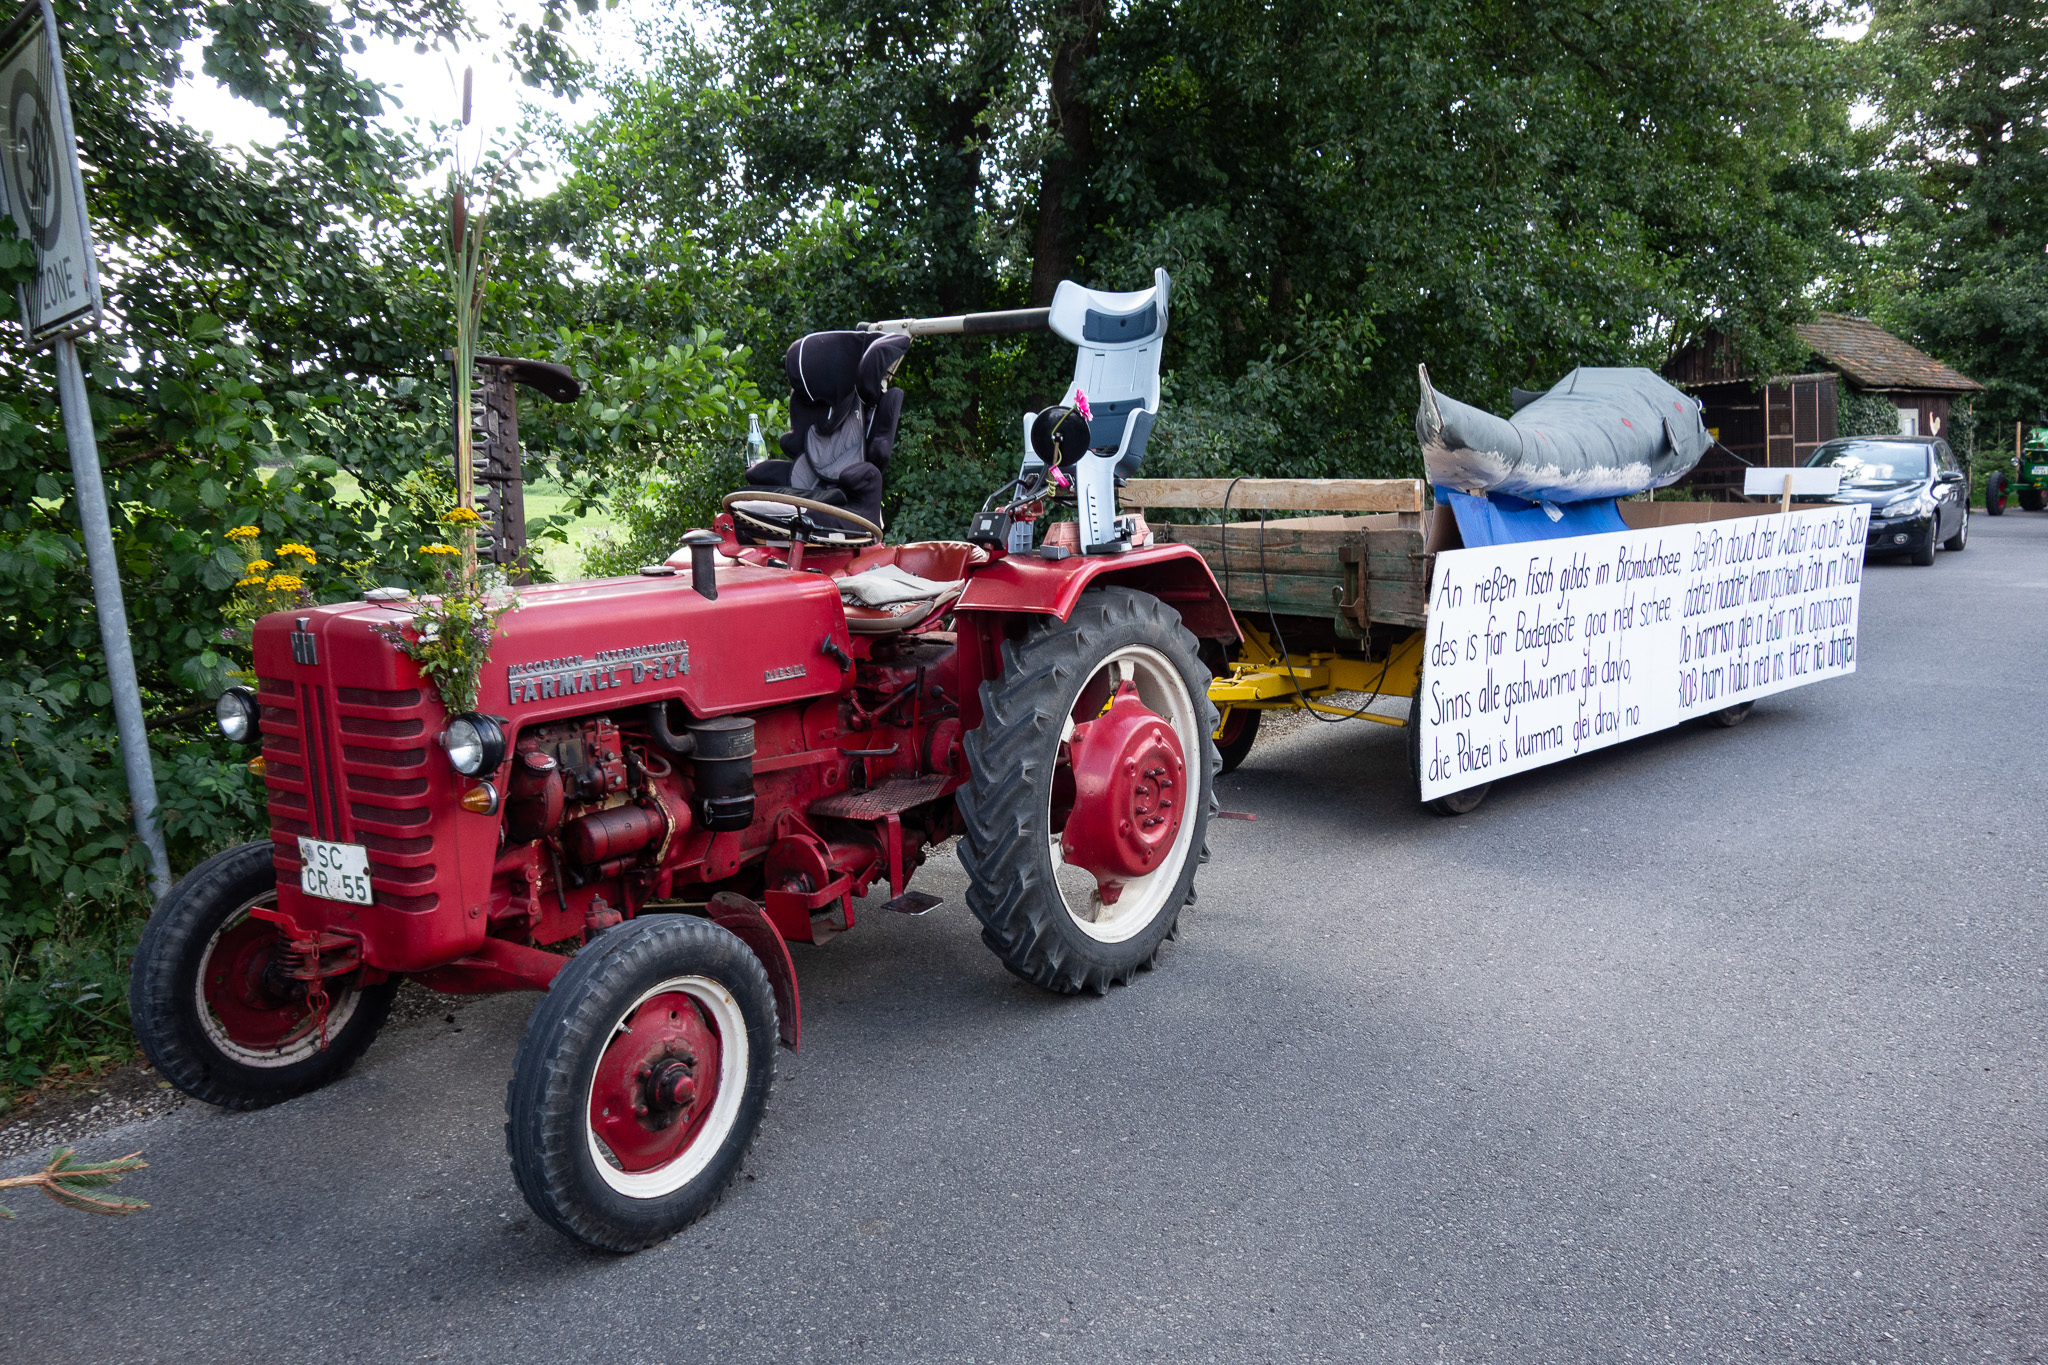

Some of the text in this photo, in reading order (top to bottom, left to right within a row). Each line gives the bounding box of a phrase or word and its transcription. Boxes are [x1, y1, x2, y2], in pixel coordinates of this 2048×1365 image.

[39, 256, 76, 311] ZONE
[1757, 518, 1777, 560] der
[1778, 513, 1812, 556] Waller
[1436, 568, 1463, 611] An
[1526, 557, 1554, 596] Fisch
[1557, 551, 1591, 610] gibds
[1595, 561, 1610, 586] im
[1683, 572, 1715, 618] dabei
[596, 640, 689, 663] INTERNATIONAL
[1431, 621, 1458, 667] des
[1466, 630, 1478, 661] is
[1516, 598, 1575, 667] Badegäste
[1613, 591, 1635, 632] ned
[1737, 609, 1754, 659] glei
[509, 654, 690, 705] FARMALL D-324
[764, 664, 806, 680] DIESEL
[1430, 680, 1472, 726] Sinns
[1478, 667, 1500, 714] alle
[1503, 657, 1576, 725] gschwumma
[1580, 648, 1597, 707] glei
[1700, 662, 1724, 703] ham
[1753, 644, 1771, 688] ned
[1772, 648, 1784, 682] ins
[1789, 640, 1810, 678] Herz
[1812, 638, 1826, 672] nei
[1428, 735, 1452, 782] die
[1456, 728, 1492, 774] Polizei
[1499, 735, 1508, 764] is
[1515, 715, 1563, 759] kumma
[1573, 698, 1590, 754] glei
[317, 844, 342, 870] SC
[307, 868, 367, 901] CR 55
